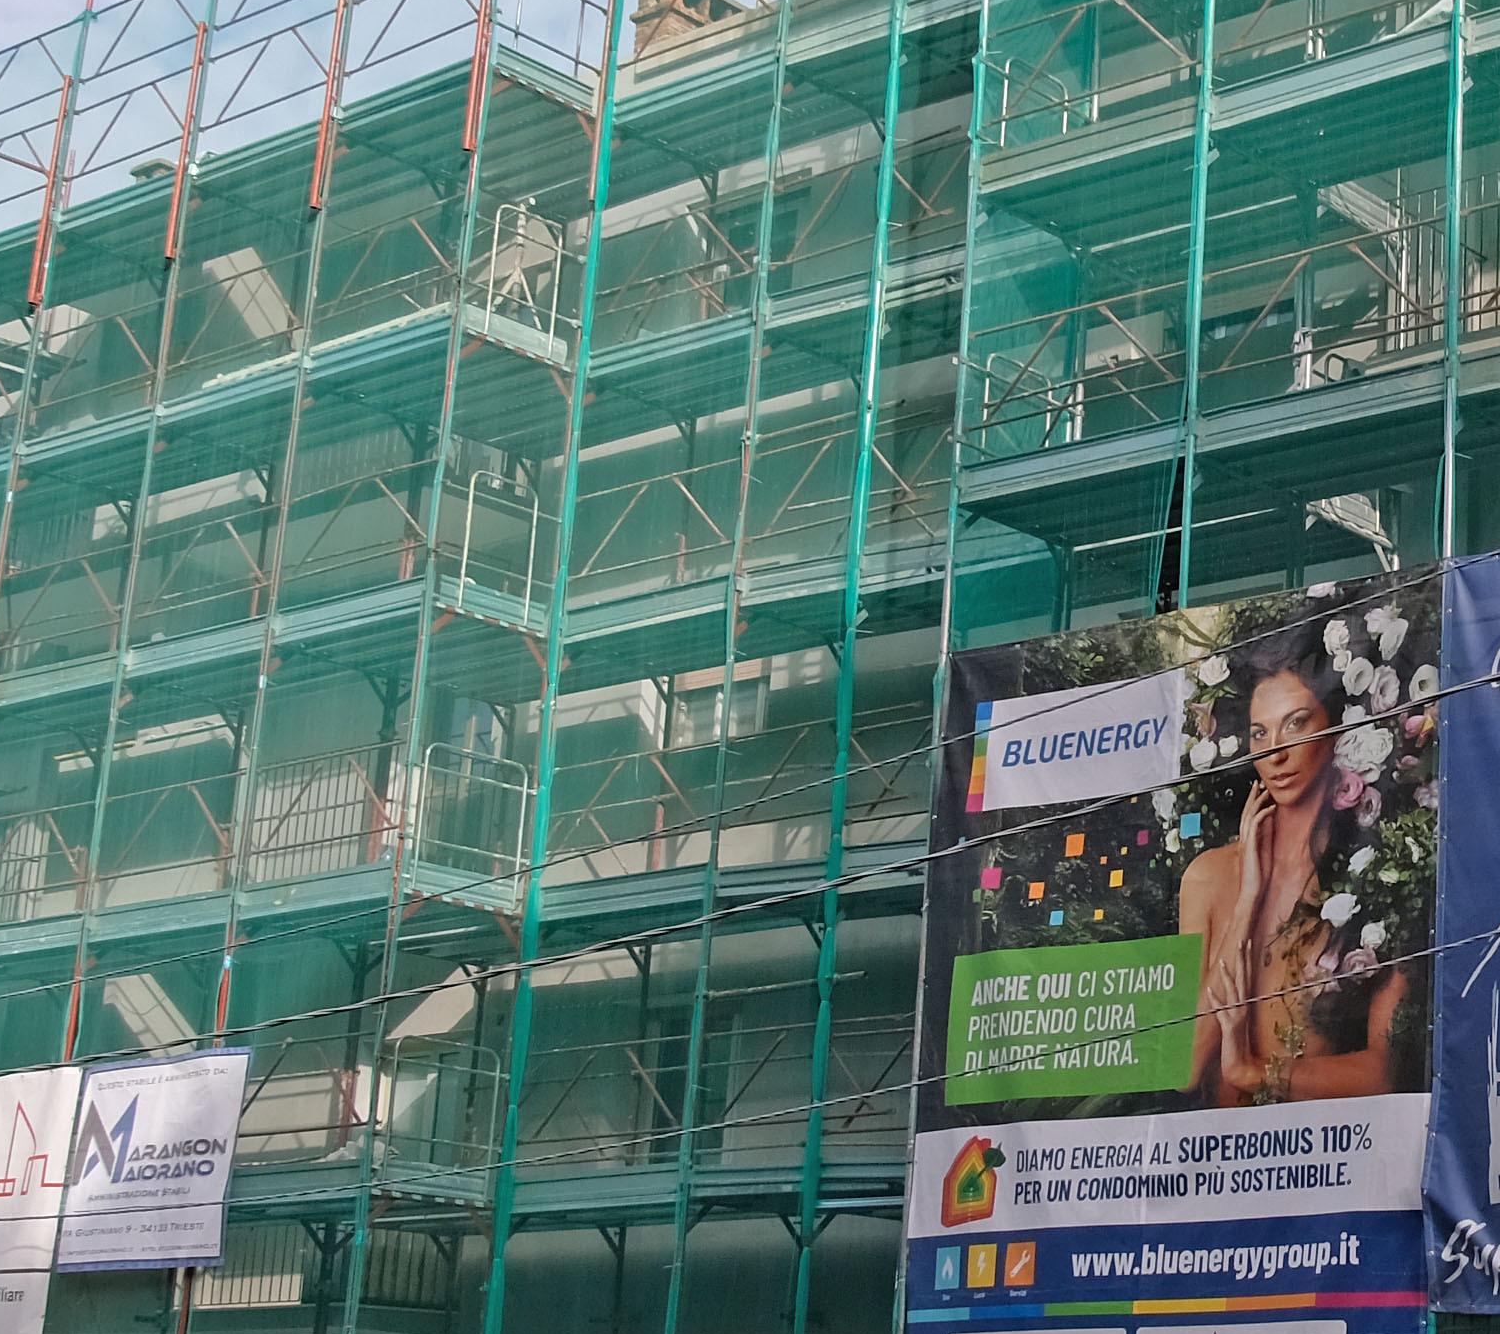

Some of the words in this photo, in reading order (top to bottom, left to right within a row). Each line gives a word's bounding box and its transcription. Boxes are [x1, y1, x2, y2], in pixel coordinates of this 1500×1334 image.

[1002, 715, 1169, 768] BLUENERGY
[971, 975, 1032, 1007] ANCHE
[1036, 972, 1072, 1003] QUI
[1077, 970, 1097, 998] CI
[1103, 963, 1175, 996] STIAMO
[967, 1007, 1078, 1042] PRENDENDO
[1083, 1003, 1137, 1032] CURA
[964, 1050, 983, 1078] DI
[988, 1043, 1048, 1075] MADRE
[1053, 1039, 1139, 1069] NATURA.
[1016, 1147, 1066, 1173] DIAMO
[1070, 1143, 1144, 1170] ENERGIA
[1149, 1140, 1172, 1166] AL
[1178, 1127, 1314, 1164] SUPERBONUS
[1320, 1122, 1373, 1154] 110%
[1014, 1181, 1042, 1205] PER
[1047, 1178, 1071, 1203] UN
[1076, 1173, 1189, 1201] CONDOMINIO
[1195, 1165, 1226, 1196] PIÙ
[1230, 1161, 1352, 1194] SOSTENIBILE.
[1072, 1231, 1360, 1280] www.bluenergygroup.it
